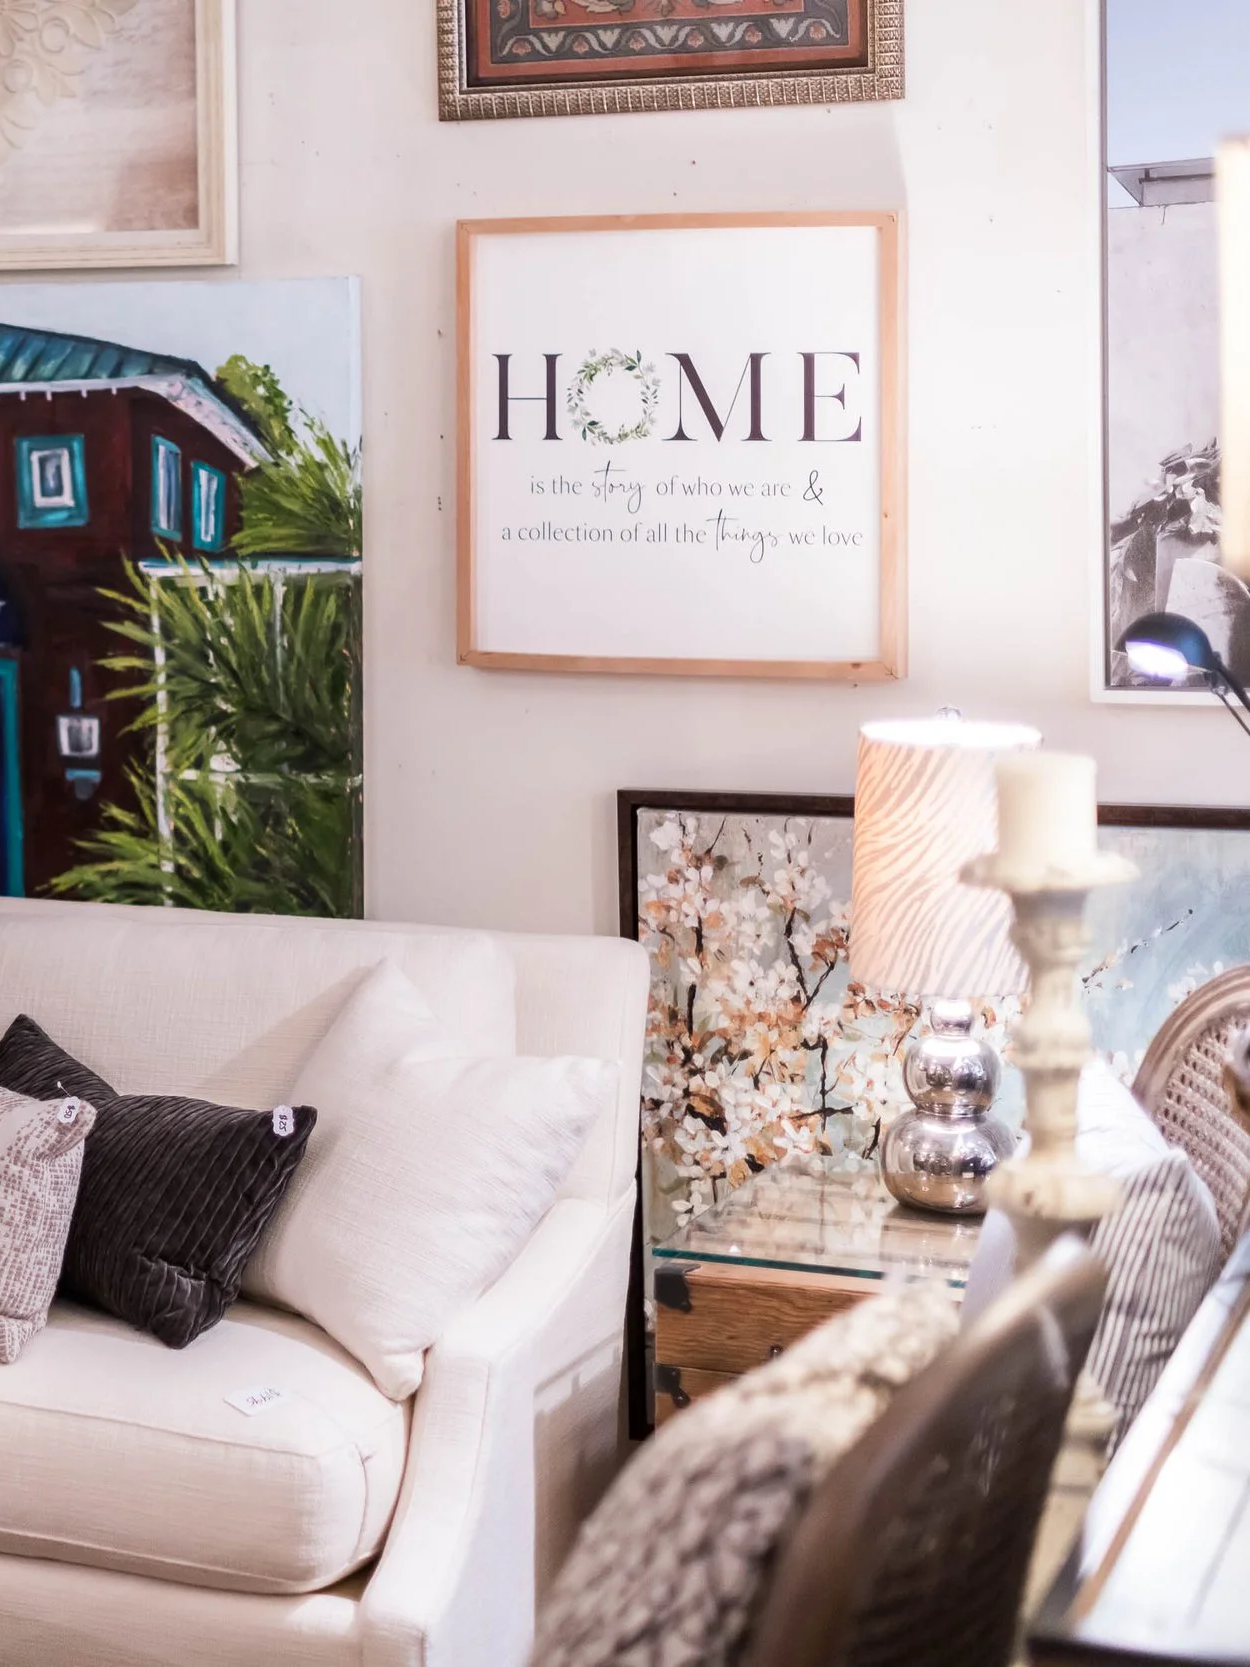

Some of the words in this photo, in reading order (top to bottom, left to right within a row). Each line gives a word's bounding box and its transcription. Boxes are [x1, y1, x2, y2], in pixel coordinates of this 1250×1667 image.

[530, 475, 545, 495] is
[552, 474, 583, 495] the
[591, 460, 646, 514] story
[656, 474, 679, 496] of
[682, 475, 723, 497] who
[728, 483, 754, 497] we
[761, 482, 791, 497] are
[802, 469, 823, 506] &
[501, 527, 511, 540] a
[518, 521, 613, 542] collection
[620, 522, 643, 542] of
[646, 522, 667, 543] all
[675, 523, 707, 543] the
[706, 508, 781, 563] things
[789, 529, 815, 545] we
[822, 525, 863, 546] love
[278, 1114, 288, 1132] $25
